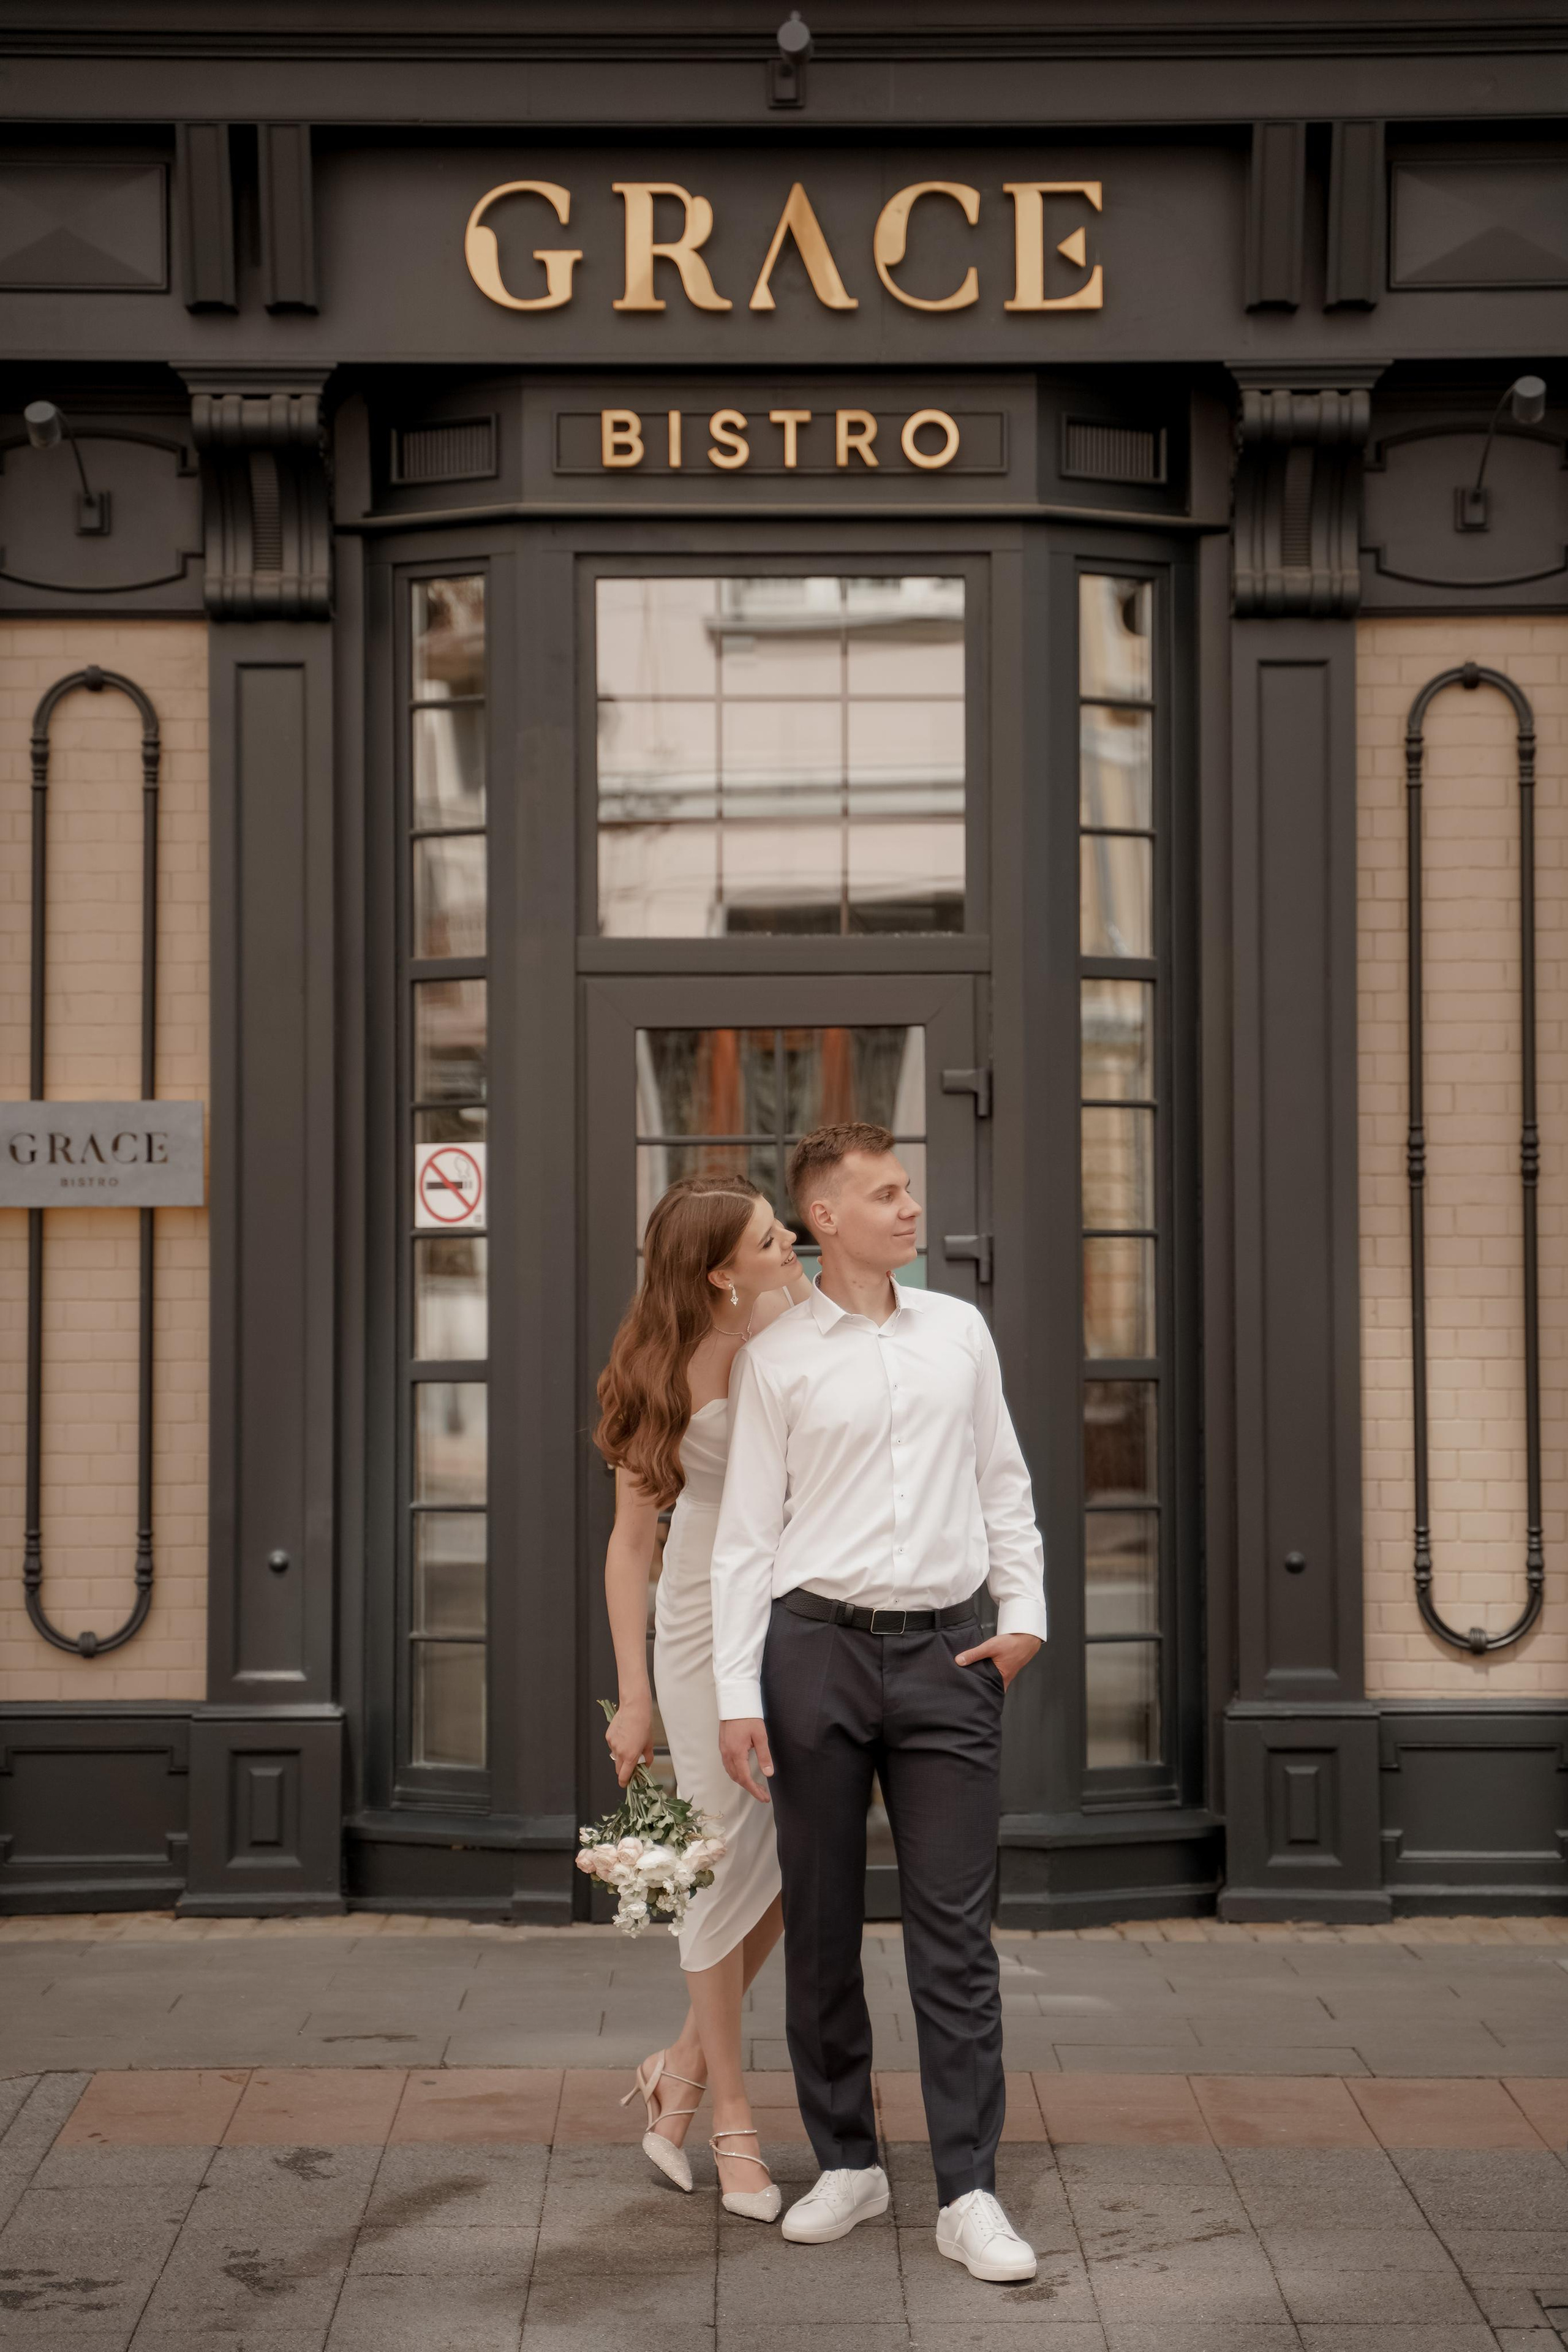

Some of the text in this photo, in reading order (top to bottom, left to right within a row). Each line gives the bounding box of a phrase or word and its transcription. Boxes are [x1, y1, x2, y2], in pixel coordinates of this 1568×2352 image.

[465, 180, 1102, 311] GRACE
[601, 409, 960, 469] BISTRO
[9, 1132, 168, 1164] GRACE
[60, 1177, 119, 1187] BISTRO
